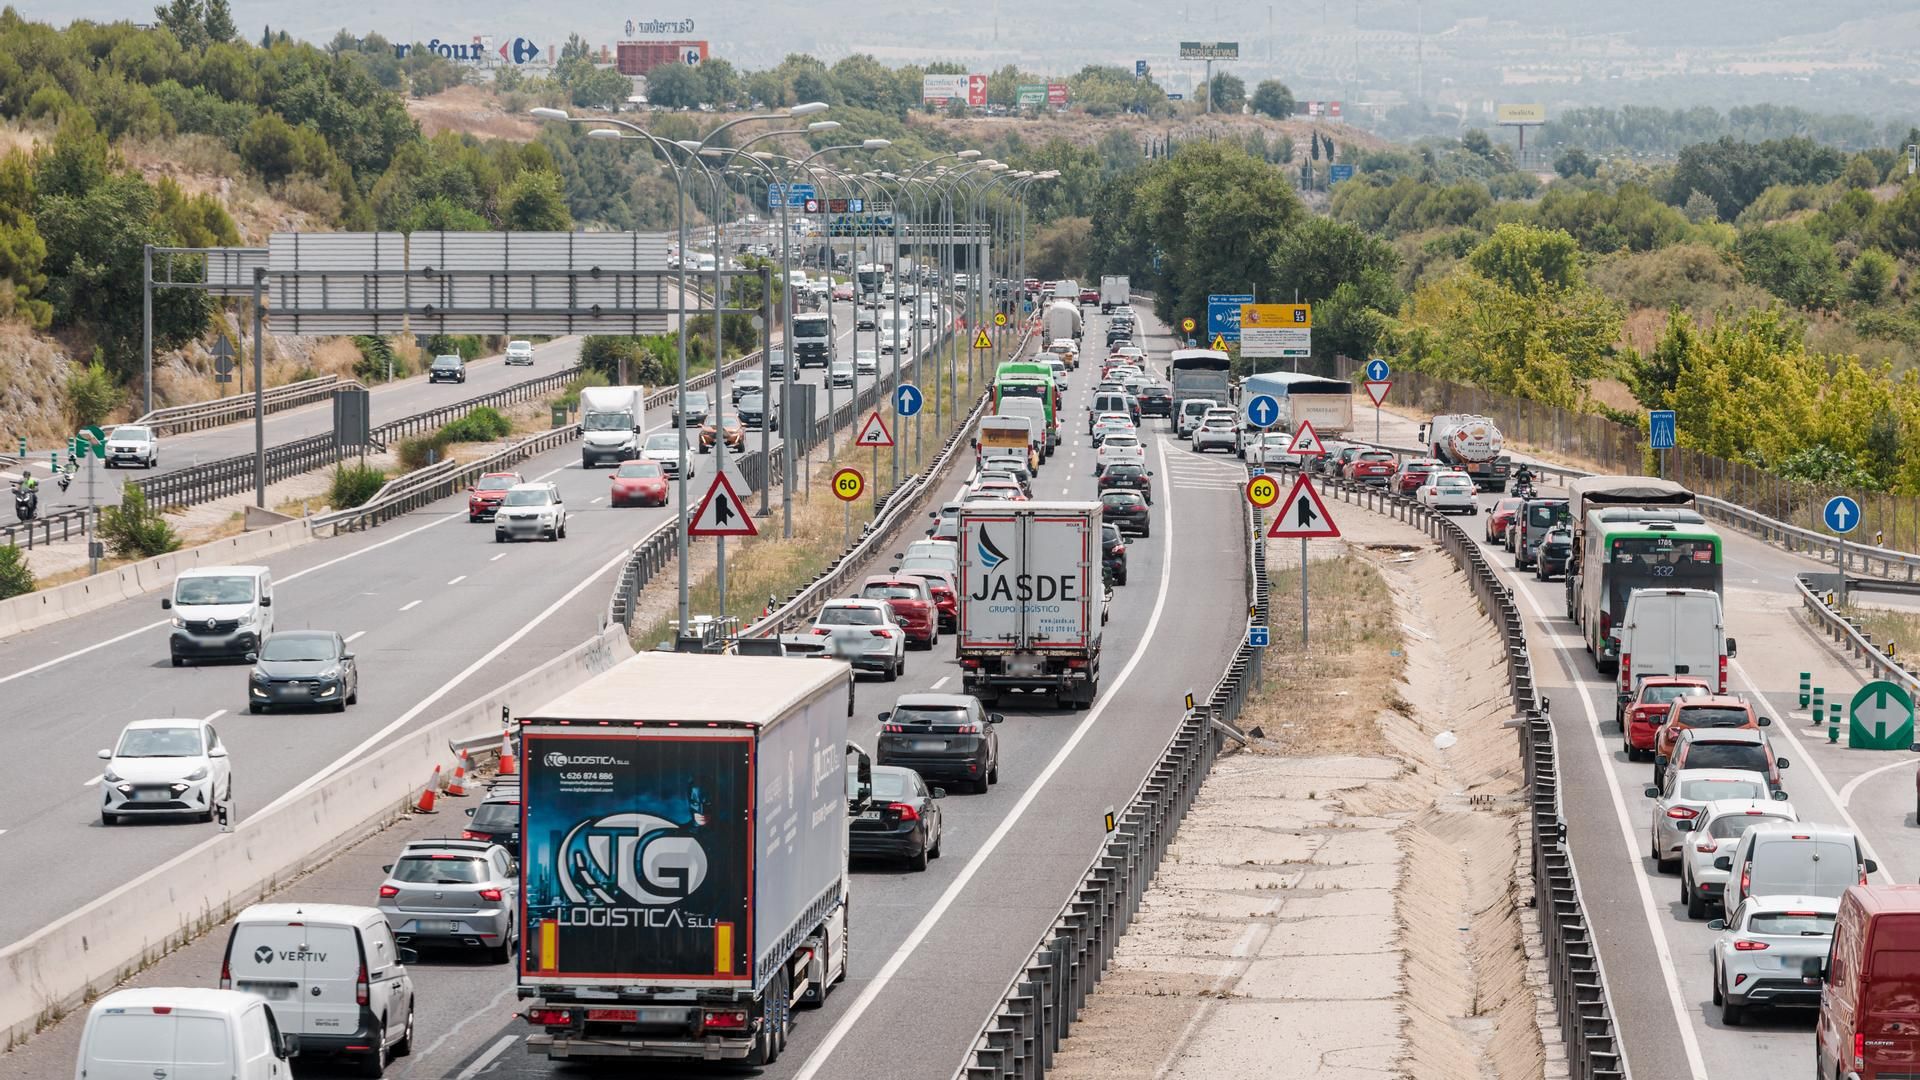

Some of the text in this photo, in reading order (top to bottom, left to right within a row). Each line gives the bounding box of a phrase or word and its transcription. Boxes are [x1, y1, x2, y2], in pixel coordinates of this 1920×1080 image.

[1181, 48, 1211, 57] PARQUE
[839, 479, 857, 490] 60
[1254, 485, 1272, 497] 60
[1653, 565, 1674, 577] 332
[972, 574, 1076, 602] JASDE
[989, 603, 1060, 613] GRUPO LOGÍSTICO
[1255, 635, 1262, 643] 4
[567, 756, 616, 765] LOGISTICA
[566, 772, 582, 780] 626
[583, 772, 597, 780] 874
[557, 907, 684, 928] LOGISTICA
[279, 951, 327, 962] VERTIV
